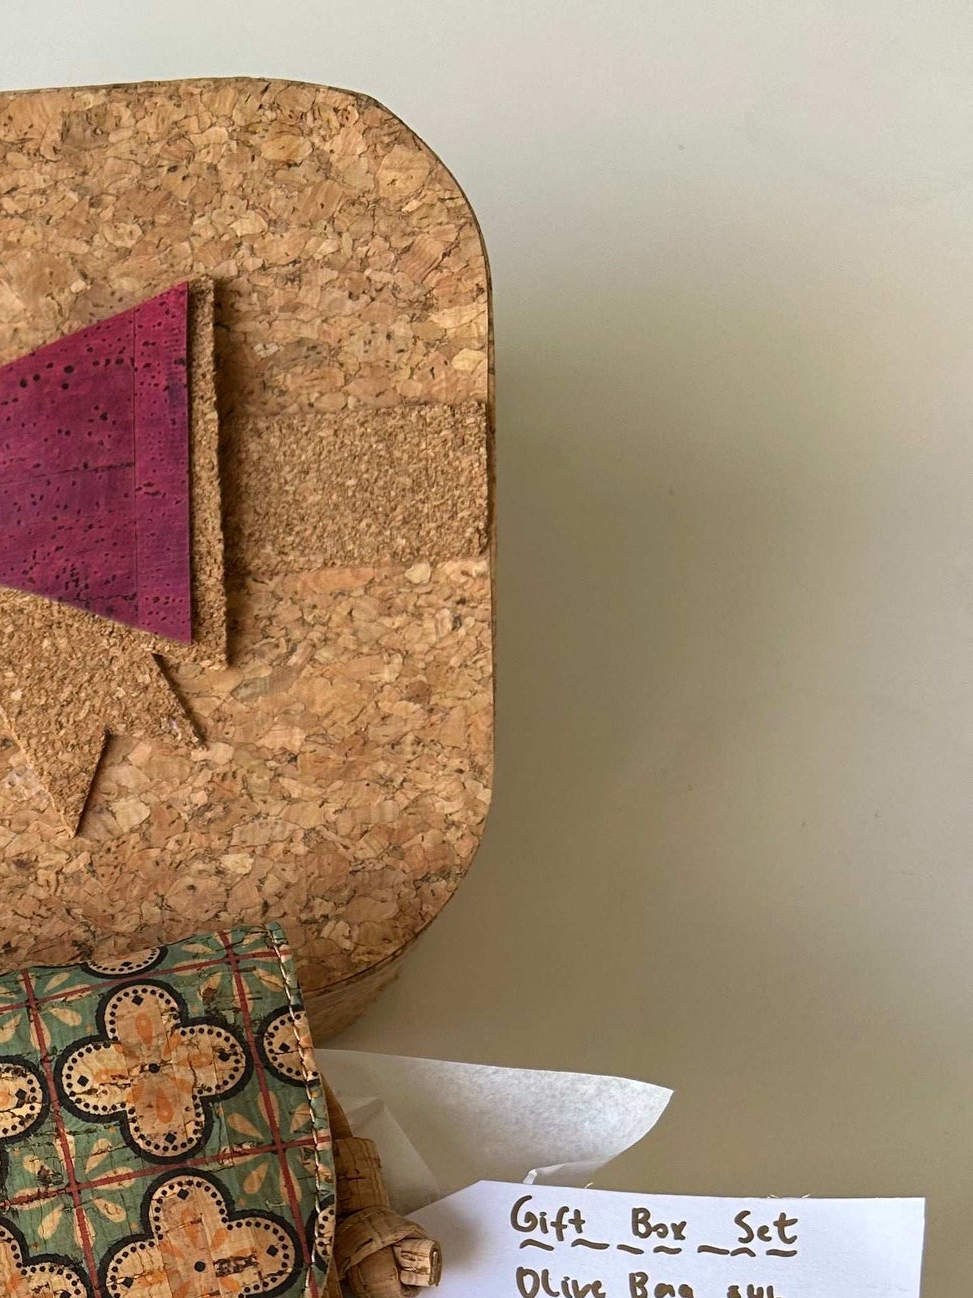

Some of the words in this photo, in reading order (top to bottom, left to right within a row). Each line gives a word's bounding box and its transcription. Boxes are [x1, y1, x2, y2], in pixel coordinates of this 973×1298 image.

[510, 1194, 586, 1242] Gift
[631, 1207, 687, 1241] Box
[734, 1210, 799, 1245] Set
